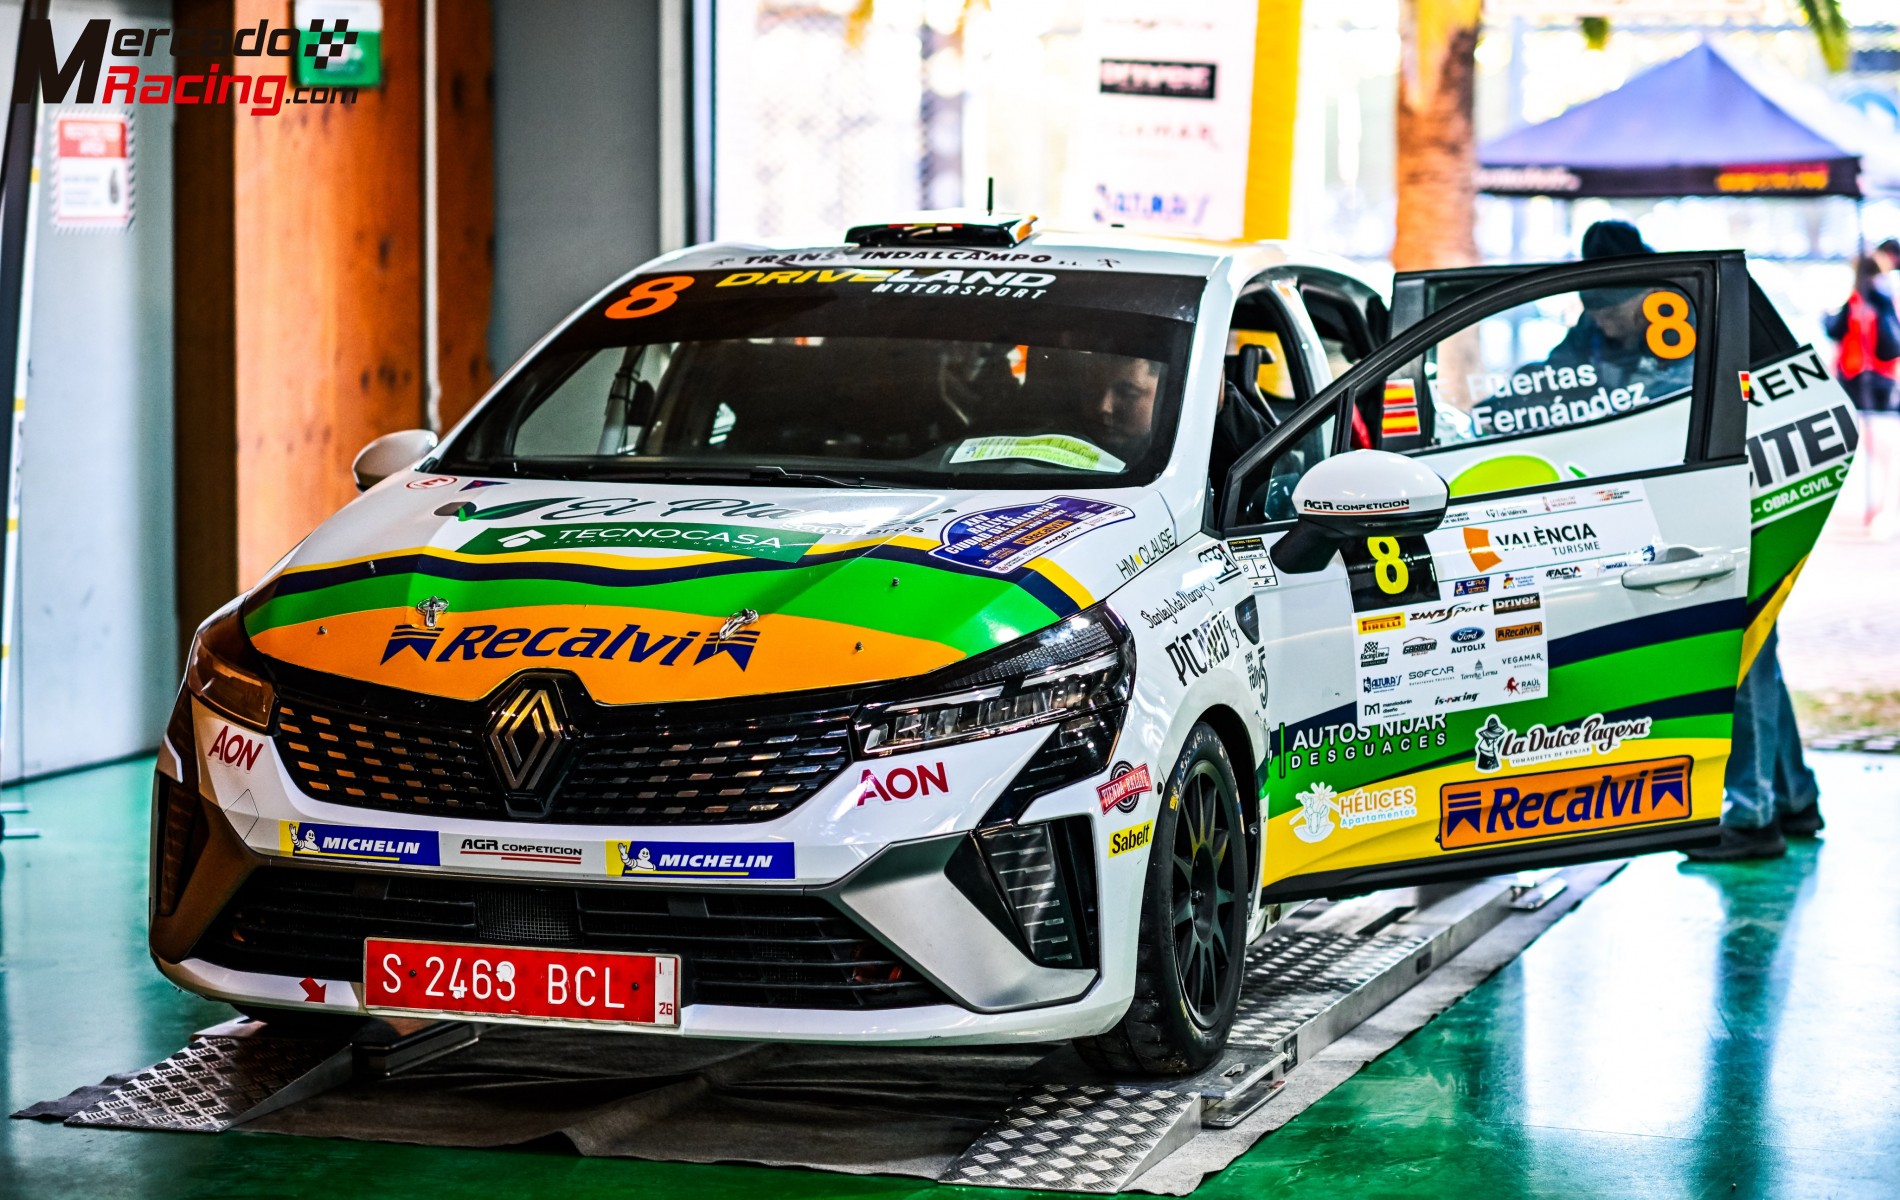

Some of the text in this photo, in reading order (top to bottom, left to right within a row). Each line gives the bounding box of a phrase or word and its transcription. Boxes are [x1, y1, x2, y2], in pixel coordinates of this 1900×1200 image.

[860, 250, 1053, 264] INDALCAMPO
[715, 269, 1056, 288] DRIVELAND
[604, 275, 696, 320] 8
[872, 283, 1047, 300] MOTORSPORT
[1642, 291, 1697, 360] 8
[1472, 382, 1650, 436] Fernández
[1762, 489, 1800, 513] OBRA
[1800, 475, 1833, 497] CIVIL
[1304, 499, 1410, 511] AGR COMPETICION
[558, 528, 781, 549] TECNOCASA
[944, 531, 993, 555] CIUDAD
[988, 524, 1010, 534] DE
[1003, 502, 1062, 527] VALENCIA
[1552, 541, 1601, 557] TURISME
[1367, 536, 1409, 595] 8
[1361, 616, 1401, 631] PIRELLI
[1504, 624, 1532, 638] Recalvi
[435, 623, 702, 667] Recalvi
[1457, 629, 1479, 641] Ford
[1451, 643, 1486, 655] AUTOLIX
[1501, 653, 1544, 665] VEGAMAR
[1408, 666, 1455, 680] SOFCAR
[1521, 678, 1541, 688] RAÚL
[1292, 723, 1371, 752] AUTOS
[1528, 727, 1580, 752] Dulce
[1583, 717, 1645, 752] Pagesa
[208, 725, 263, 771] AON
[1291, 733, 1447, 769] DESGUACES
[856, 761, 949, 807] AON
[1101, 781, 1126, 808] TIENDA
[1340, 787, 1415, 815] HÉLICES
[1486, 769, 1649, 834] Recalvi
[1341, 808, 1416, 826] Apartamentos
[322, 836, 421, 855] MICHELIN
[461, 838, 583, 856] AGR COMPETICION
[1112, 823, 1151, 854] Sabelt
[658, 853, 773, 868] MICHELIN
[382, 953, 402, 994] S
[547, 963, 625, 1009] BCL
[658, 1002, 673, 1015] 26
